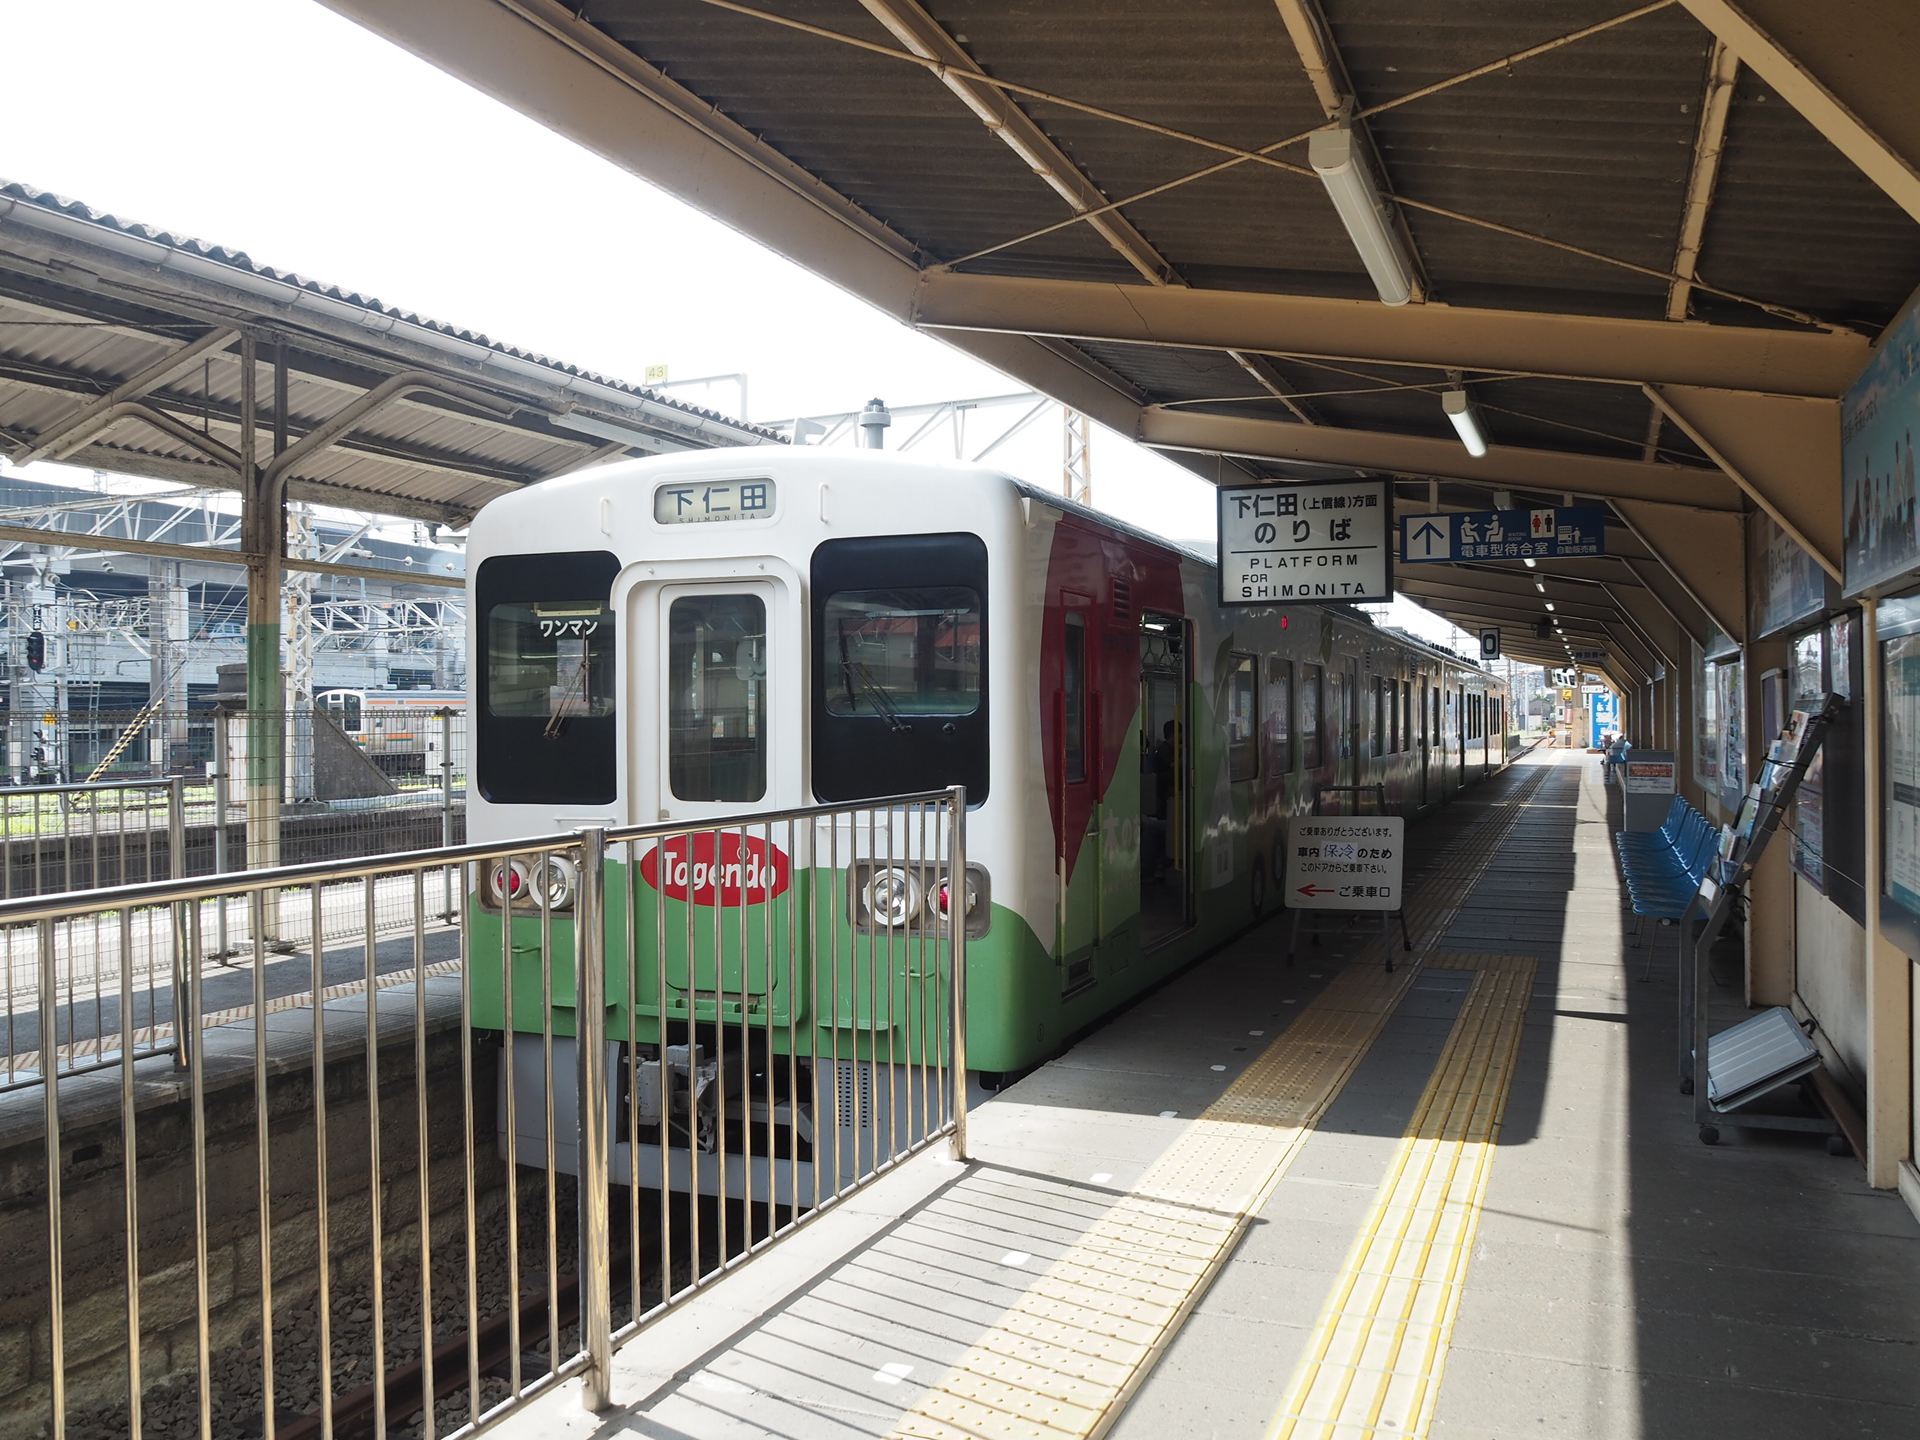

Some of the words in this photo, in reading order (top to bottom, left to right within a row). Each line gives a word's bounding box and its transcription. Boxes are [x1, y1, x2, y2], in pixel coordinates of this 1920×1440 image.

[666, 484, 766, 515] 下仁田
[679, 513, 756, 523] SHIMONITA
[1254, 518, 1352, 544] のりば
[1460, 542, 1549, 558] 電車型待合室
[1250, 554, 1358, 569] PLATFORM
[1242, 573, 1268, 584] FOR
[1241, 583, 1365, 598] SHIMONITA
[540, 618, 598, 638] ワンマン
[1299, 827, 1392, 837] ご乗車ありがとうございます。
[1301, 863, 1387, 873] このドアからご乗車下さい。
[1338, 885, 1391, 898] ご乗車口
